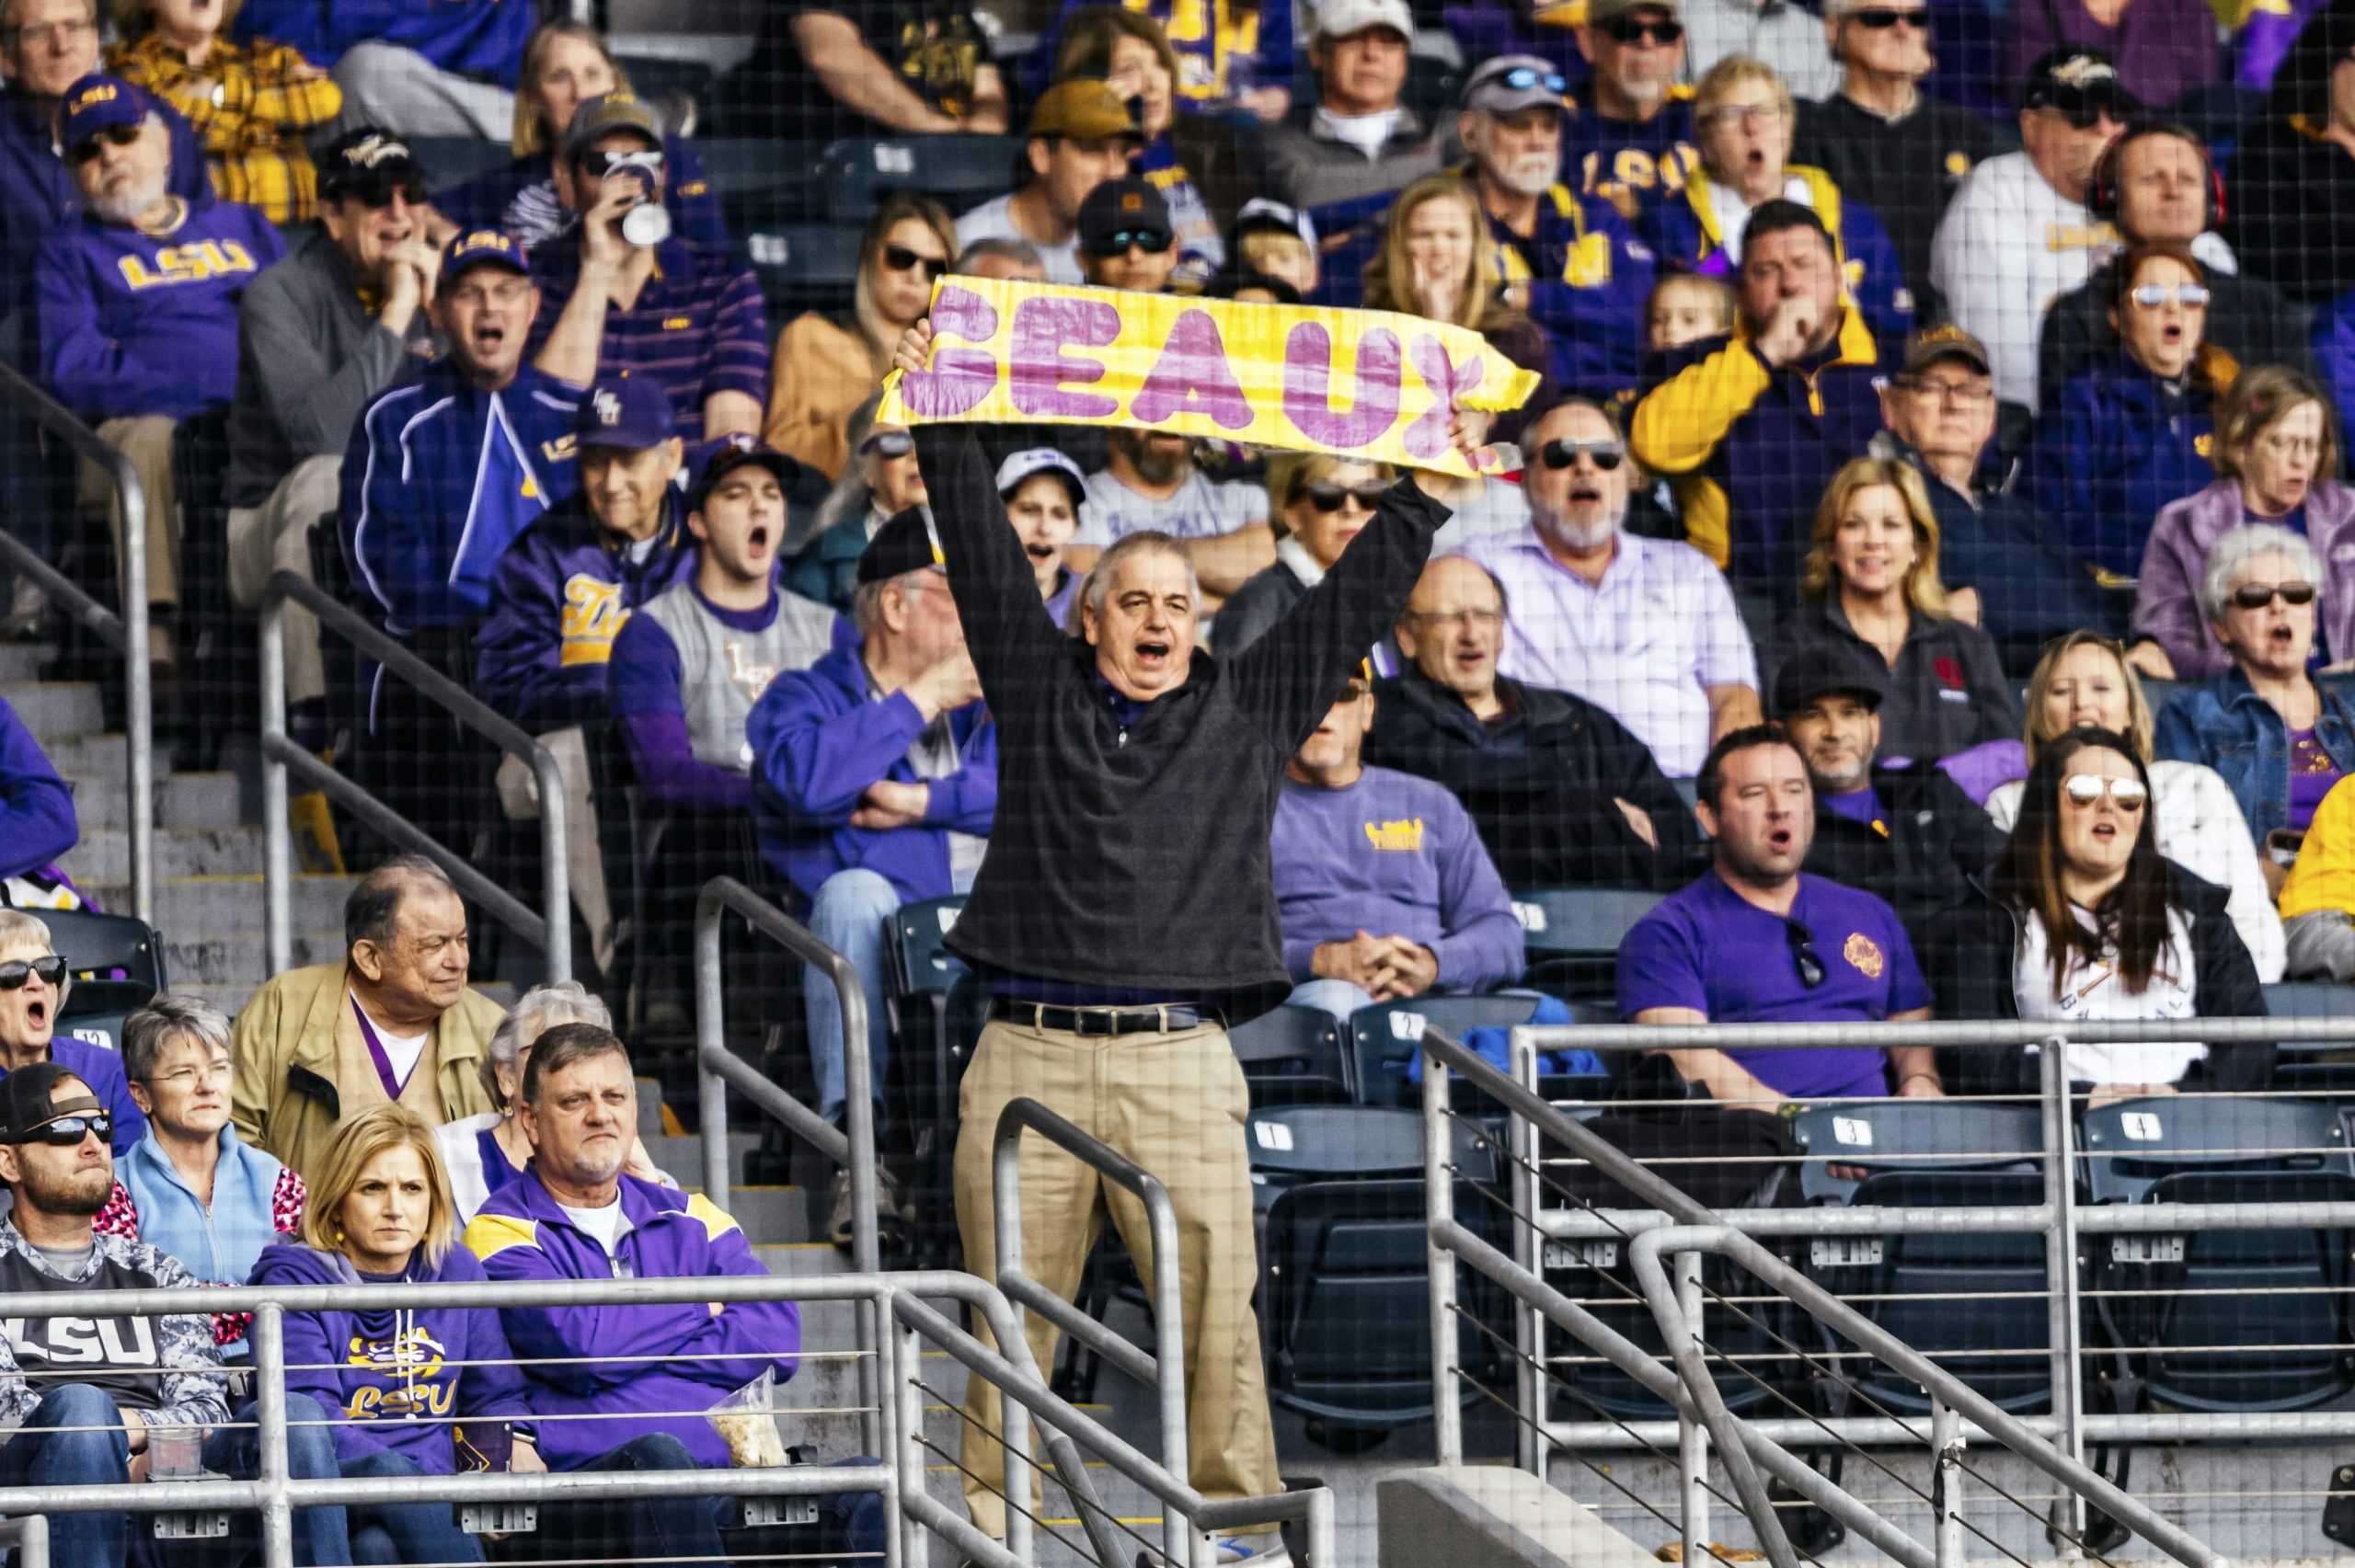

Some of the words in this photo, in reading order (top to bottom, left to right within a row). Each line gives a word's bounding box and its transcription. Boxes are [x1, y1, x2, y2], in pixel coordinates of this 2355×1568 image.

[118, 239, 258, 291] LSU
[902, 285, 1483, 460] BEAUX
[1402, 1013, 1414, 1036] 2
[1268, 1125, 1277, 1147] 1
[1846, 1119, 1857, 1142] 3
[2136, 1116, 2147, 1138] 4
[5, 1317, 157, 1366] LSU
[341, 1379, 457, 1419] LSU
